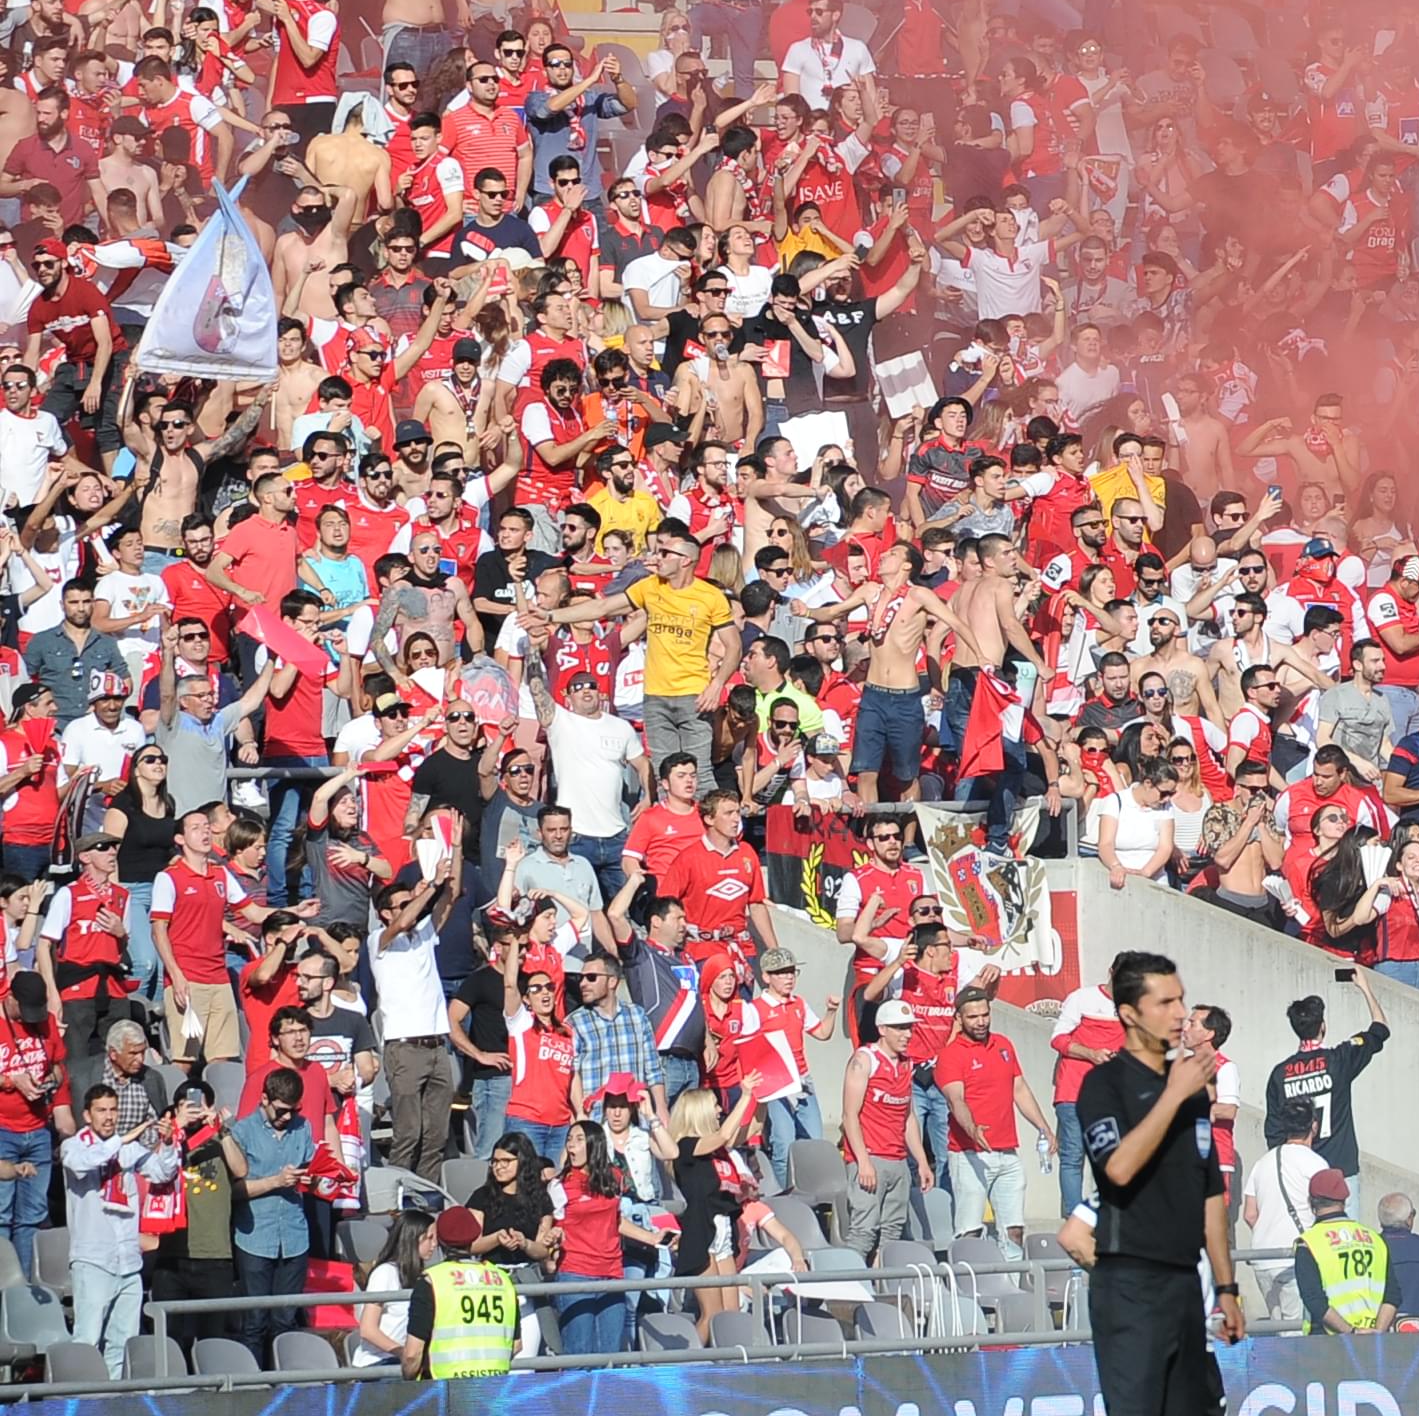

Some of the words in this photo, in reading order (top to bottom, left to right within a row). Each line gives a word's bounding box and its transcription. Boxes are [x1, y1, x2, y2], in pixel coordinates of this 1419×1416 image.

[799, 181, 844, 202] ISAVE
[1367, 236, 1396, 248] Brag
[1369, 226, 1396, 237] FORU
[654, 624, 694, 639] Braga
[1283, 1057, 1327, 1079] 2045
[1283, 1074, 1333, 1099] RICARDO
[1314, 1092, 1332, 1140] 7
[460, 1295, 505, 1325] 945
